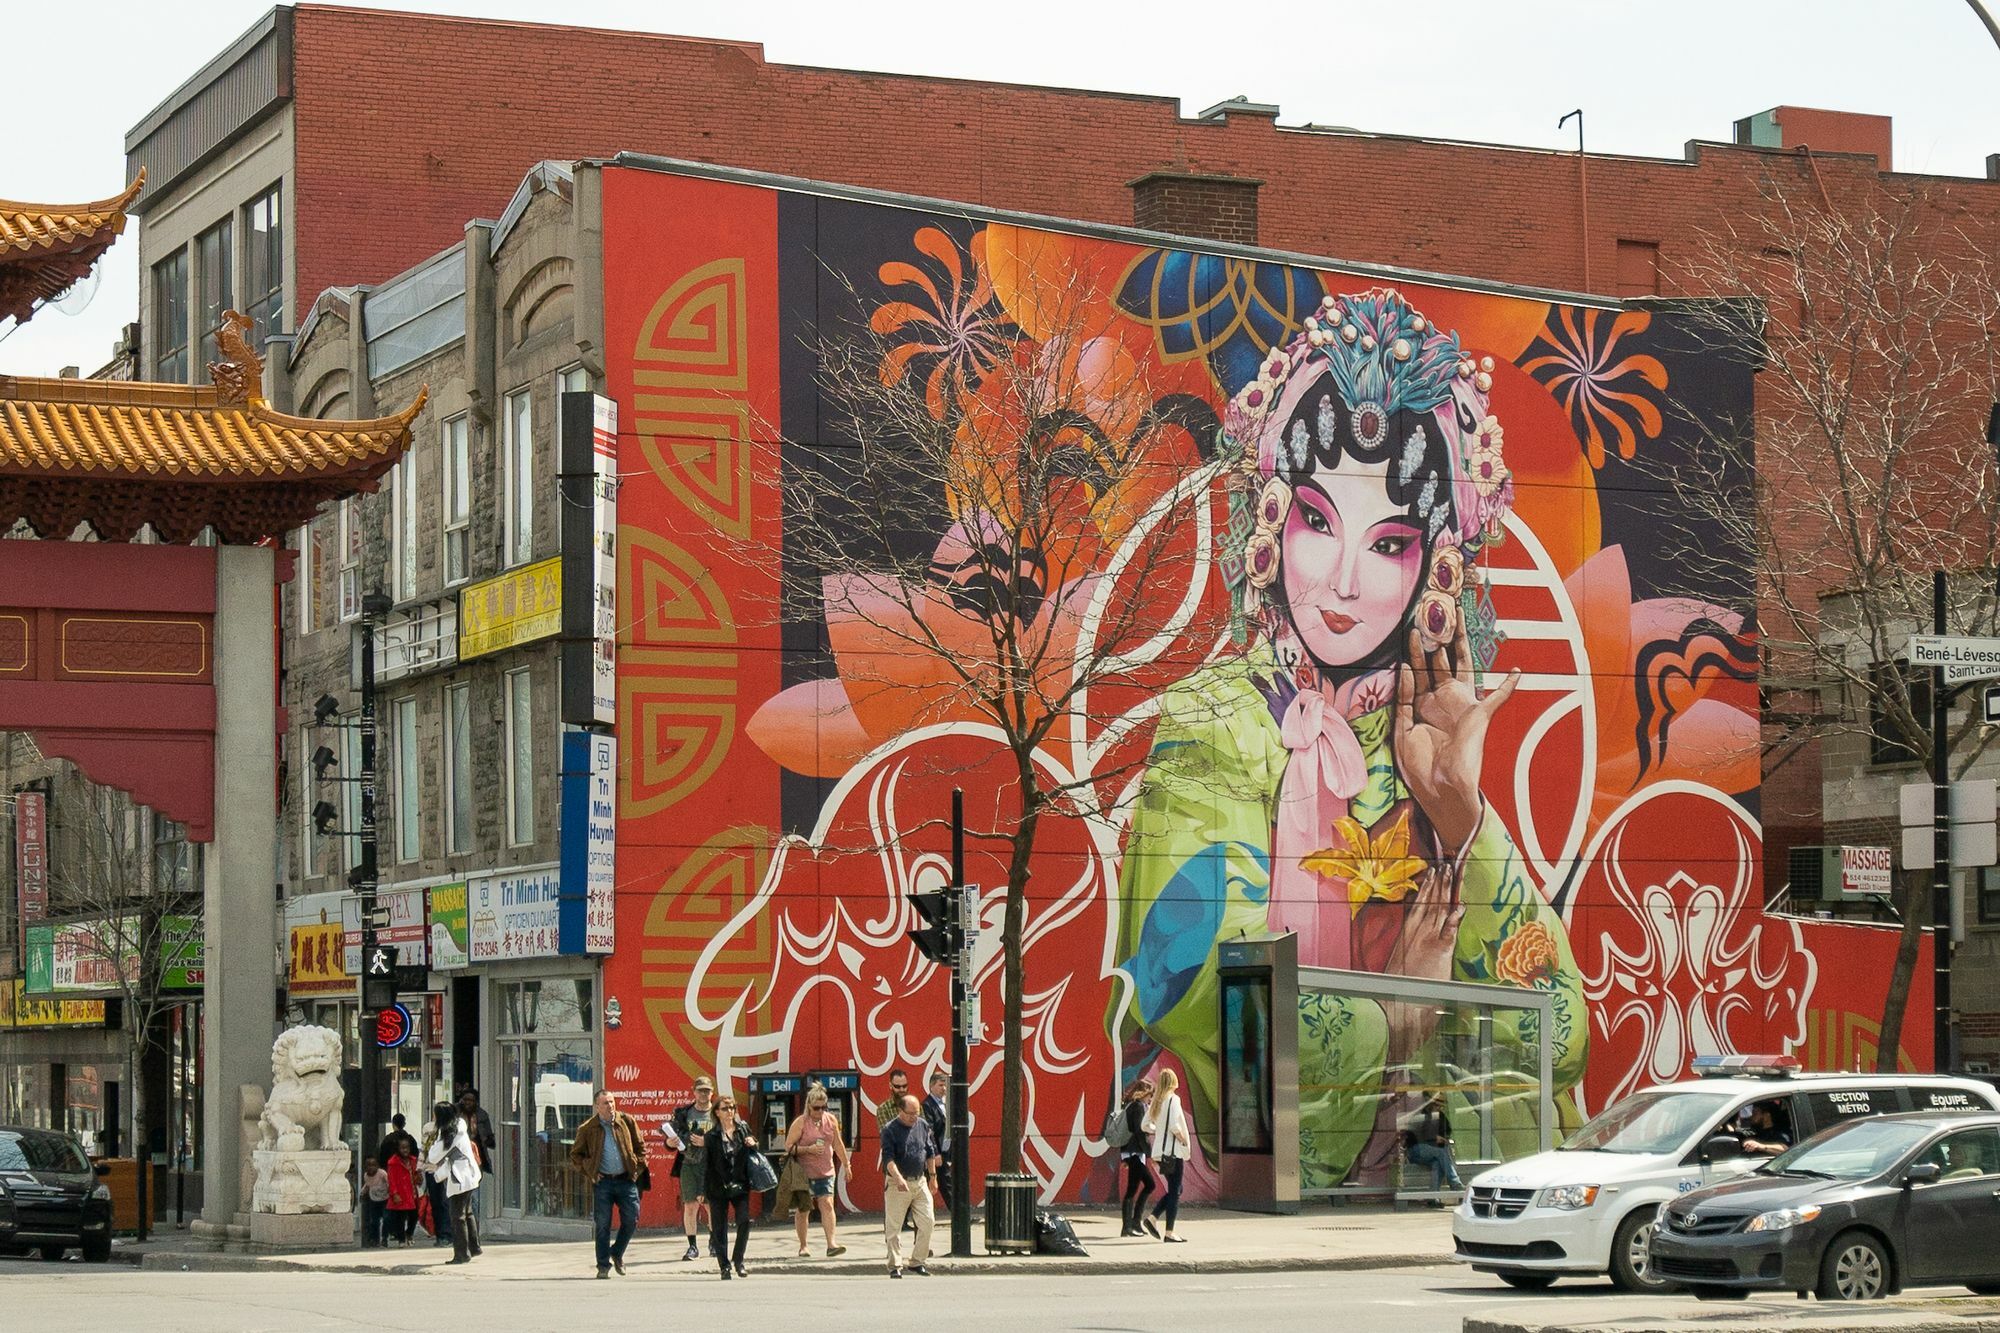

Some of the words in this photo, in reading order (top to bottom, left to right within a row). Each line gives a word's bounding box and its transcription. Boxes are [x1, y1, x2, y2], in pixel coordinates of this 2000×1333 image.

[598, 778, 609, 797] Tri
[593, 799, 612, 818] Minh
[589, 822, 614, 845] Huynh
[23, 843, 41, 894] FUNG
[1843, 850, 1890, 870] MASSAGE
[501, 881, 514, 907] Tri
[516, 877, 539, 905] Minh
[504, 912, 529, 930] OPTICIEN
[530, 911, 540, 927] DU
[474, 941, 498, 956] 875-2345
[587, 934, 614, 947] 875-2345
[772, 1080, 791, 1092] Bell
[829, 1077, 848, 1088] Bell
[1829, 1092, 1870, 1103] SECTION
[1930, 1094, 1969, 1106] ÉQUIPE
[1838, 1102, 1871, 1114] MÉTRO
